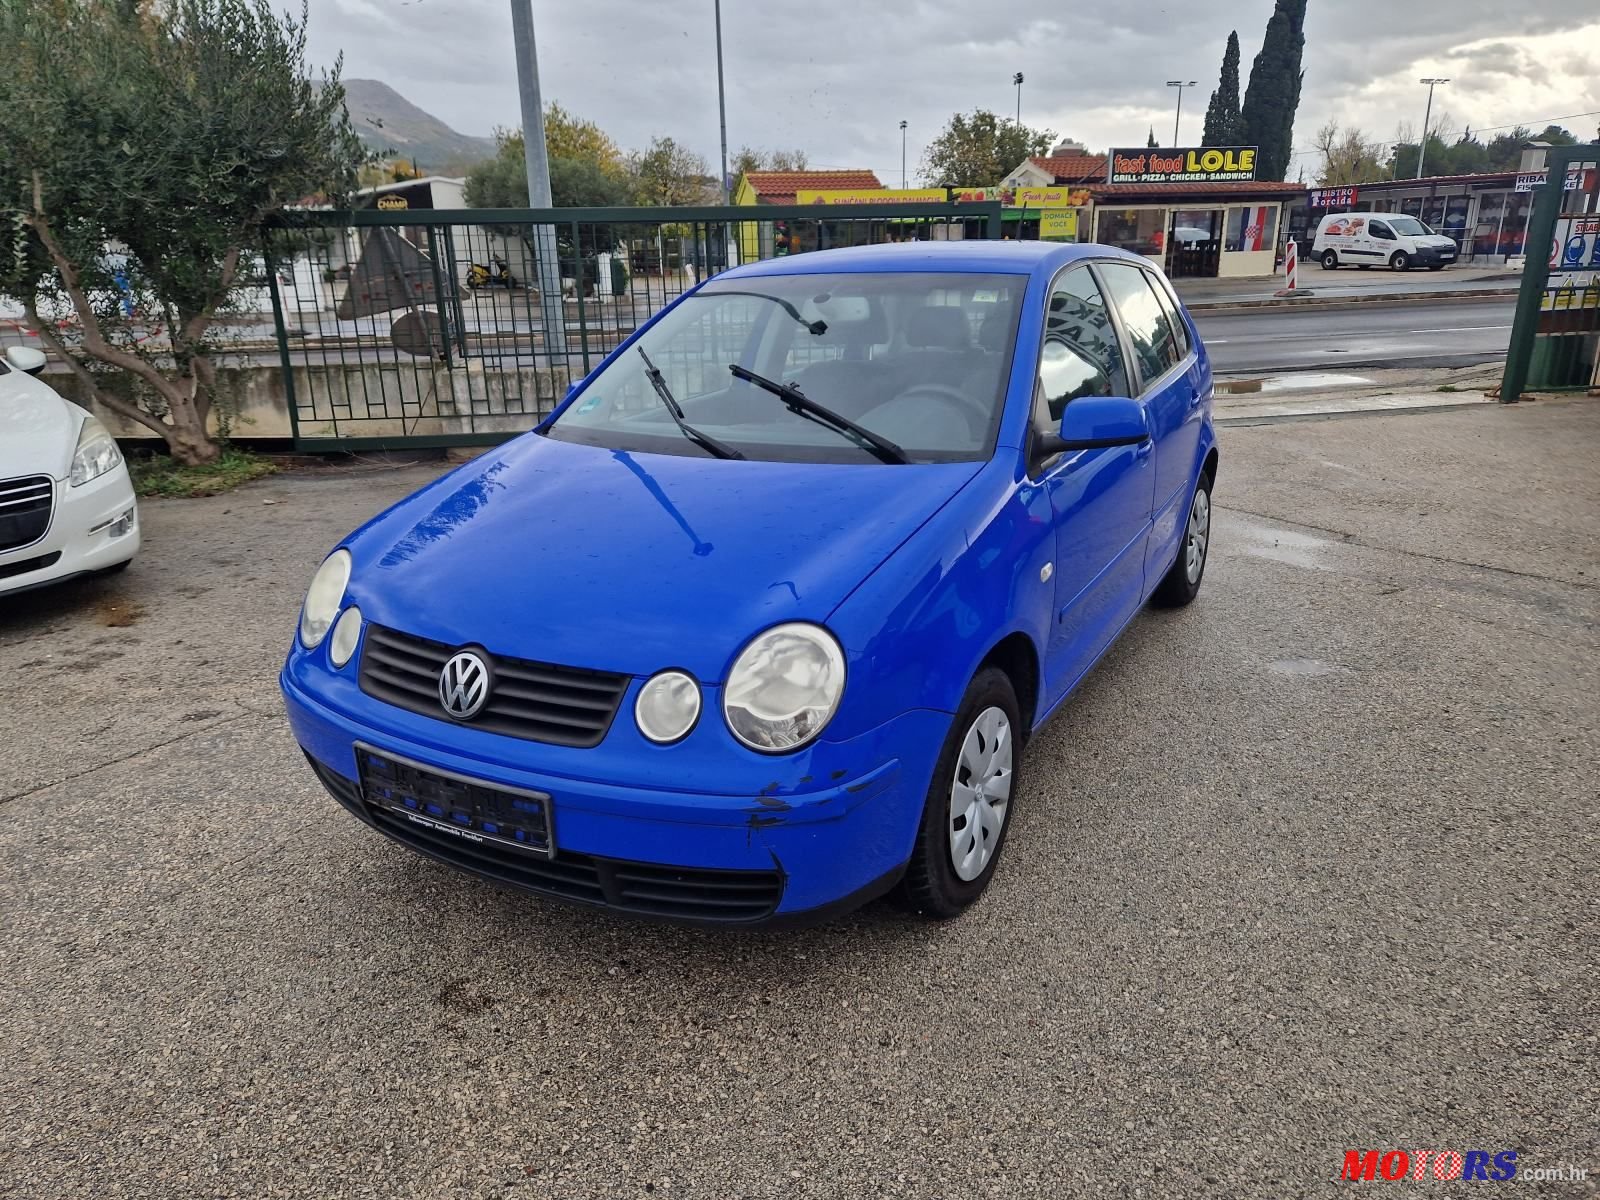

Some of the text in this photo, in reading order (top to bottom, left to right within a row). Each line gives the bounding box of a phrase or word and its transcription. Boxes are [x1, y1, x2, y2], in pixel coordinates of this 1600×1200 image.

[1114, 149, 1255, 173] fast food LOLE
[1113, 174, 1138, 182] GRILL
[1170, 173, 1207, 181] CHICKEN
[1209, 172, 1253, 180] SANDWICH
[1321, 188, 1354, 197] BISTRO
